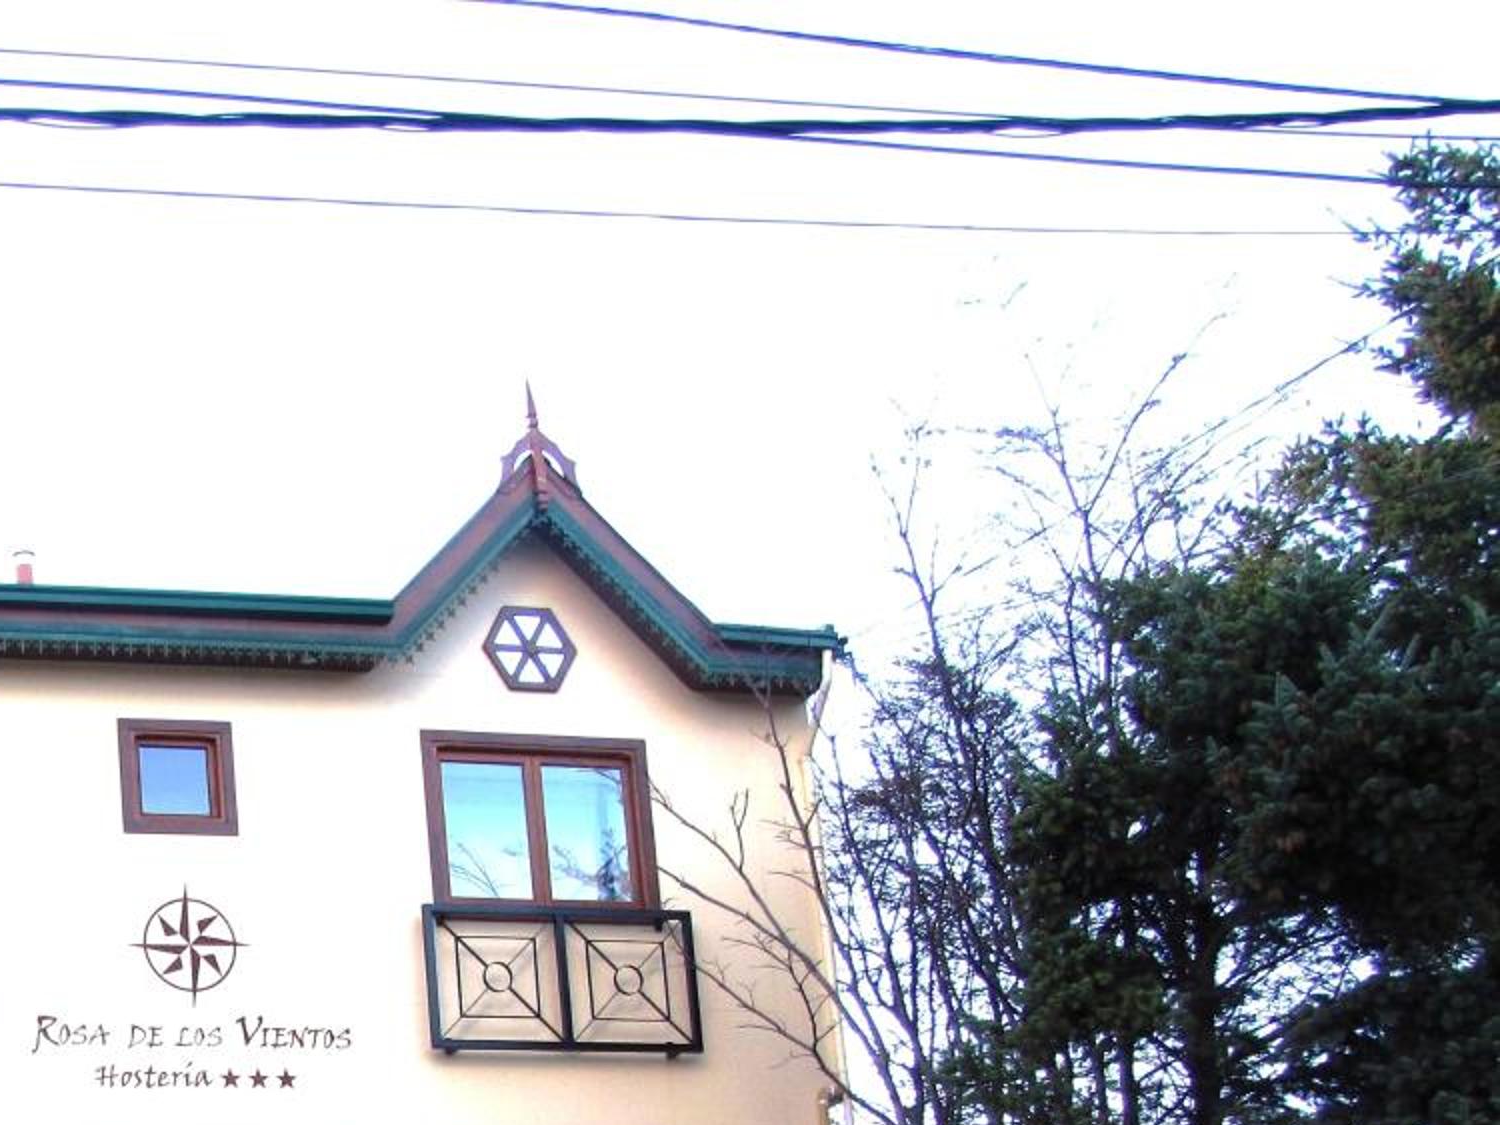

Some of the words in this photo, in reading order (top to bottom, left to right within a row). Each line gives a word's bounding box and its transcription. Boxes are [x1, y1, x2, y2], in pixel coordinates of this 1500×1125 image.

[32, 1014, 111, 1054] ROSA
[127, 1024, 165, 1049] DE
[175, 1025, 224, 1048] LOS
[235, 1014, 353, 1050] VIENTOS
[94, 1060, 214, 1090] Hostería
